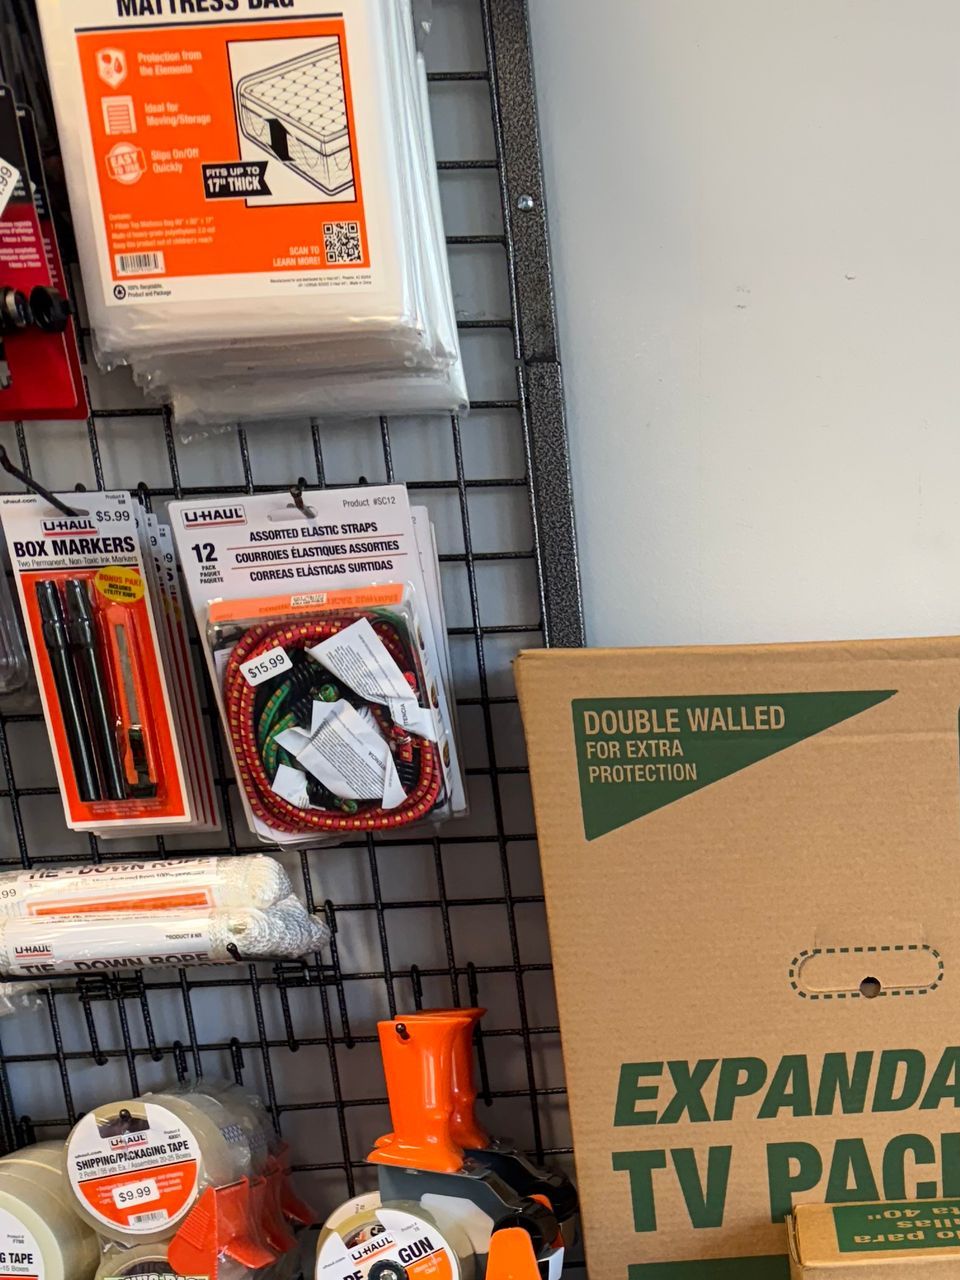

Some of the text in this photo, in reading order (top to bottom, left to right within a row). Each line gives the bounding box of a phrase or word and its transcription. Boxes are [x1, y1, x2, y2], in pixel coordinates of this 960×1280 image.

[137, 50, 202, 63] Protection from
[139, 64, 193, 76] the Elements
[166, 102, 179, 112] for
[110, 153, 139, 166] EASY
[153, 163, 183, 174] Quickly
[206, 166, 260, 177] FITS UP TO
[207, 176, 261, 193] 17" THICK
[289, 245, 320, 256] SCAN TO
[343, 499, 370, 508] Product
[96, 511, 130, 522] $5.99
[185, 508, 243, 522] U-HAUL
[43, 520, 95, 531] U-HAUL
[250, 522, 378, 542] ASSORTED ELASTIC STRAPS
[13, 536, 135, 557] BOX MARKERS
[191, 543, 218, 563] 12
[235, 540, 400, 563] COURROIES ÉLASTIQUES ASSORTIES
[111, 555, 138, 563] Markers
[200, 570, 221, 578] PAQUET
[250, 560, 393, 582] CORREAS ELÁSTICAS SURTIDAS
[200, 577, 224, 585] PAQUETE
[247, 654, 285, 679] $15.99
[583, 705, 786, 735] DOUBLE WALLED
[586, 739, 684, 760] FOR EXTRA
[588, 763, 697, 784] PROTECTION
[15, 944, 51, 954] U-HAUL
[76, 1141, 190, 1171] SHIPPING/PACKAGING TAPE
[118, 1186, 151, 1203] $9.99
[611, 1144, 733, 1233] TV
[853, 1230, 925, 1243] para
[351, 1237, 393, 1261] U-HAUL
[398, 1236, 435, 1264] GUN
[9, 1252, 34, 1264] TAPE
